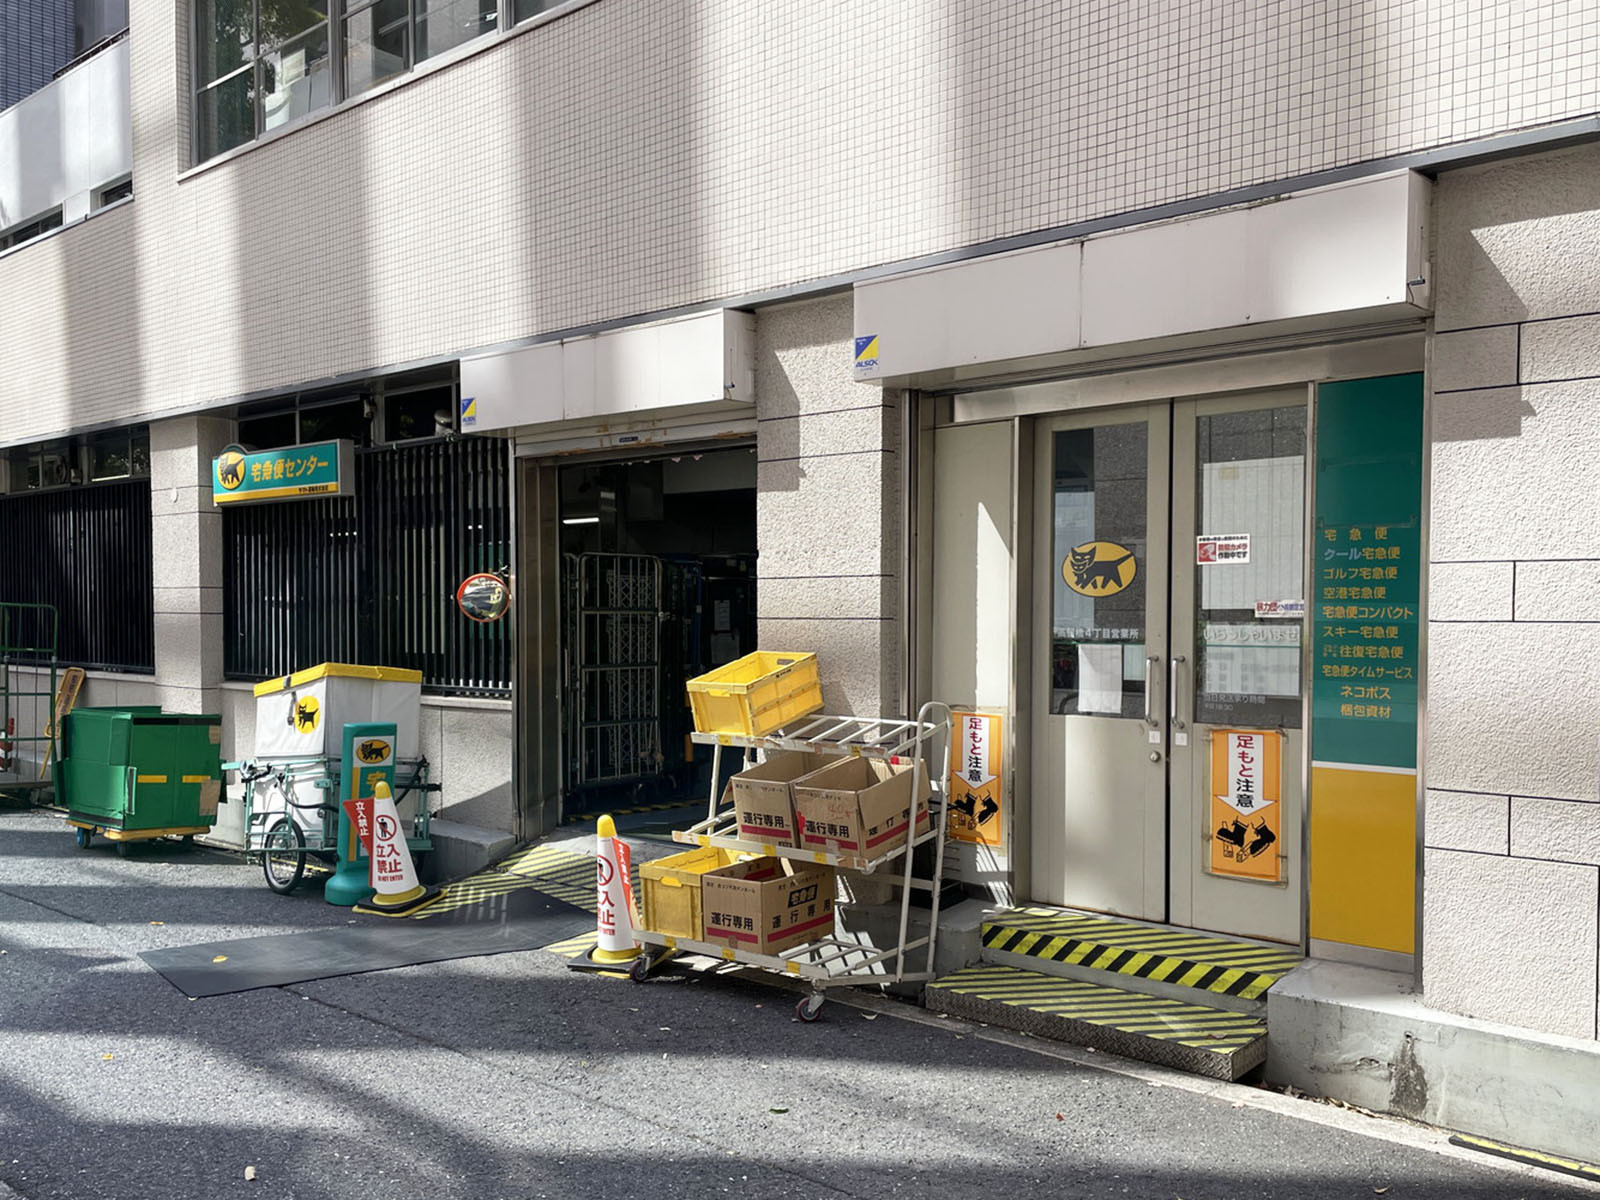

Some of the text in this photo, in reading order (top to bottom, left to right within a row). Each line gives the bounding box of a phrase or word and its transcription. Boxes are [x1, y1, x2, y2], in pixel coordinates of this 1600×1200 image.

[251, 455, 328, 482] 宅急便センター
[1324, 546, 1400, 561] クール宅急便
[1323, 566, 1398, 580] ゴルフ宅急便
[1323, 587, 1386, 599] 空港宅急便
[1322, 605, 1414, 619] 宅急便コンパクト
[1203, 627, 1298, 642] いらっしゃいませ
[1323, 625, 1399, 639] スキー宅急便
[1322, 664, 1413, 679] 宅急便タイムサービス
[1340, 685, 1391, 700] ネコポス
[1340, 703, 1391, 719] 梱包資材
[968, 717, 983, 783] 足もと注意
[1235, 734, 1255, 809] 足もと注意
[355, 801, 370, 837] 立入禁止
[743, 811, 785, 829] 運行専用
[805, 819, 850, 839] 運行専用
[376, 843, 401, 859] 立入
[377, 858, 403, 874] 禁止
[711, 911, 753, 931] 運行専用
[772, 899, 831, 929] 運行専用
